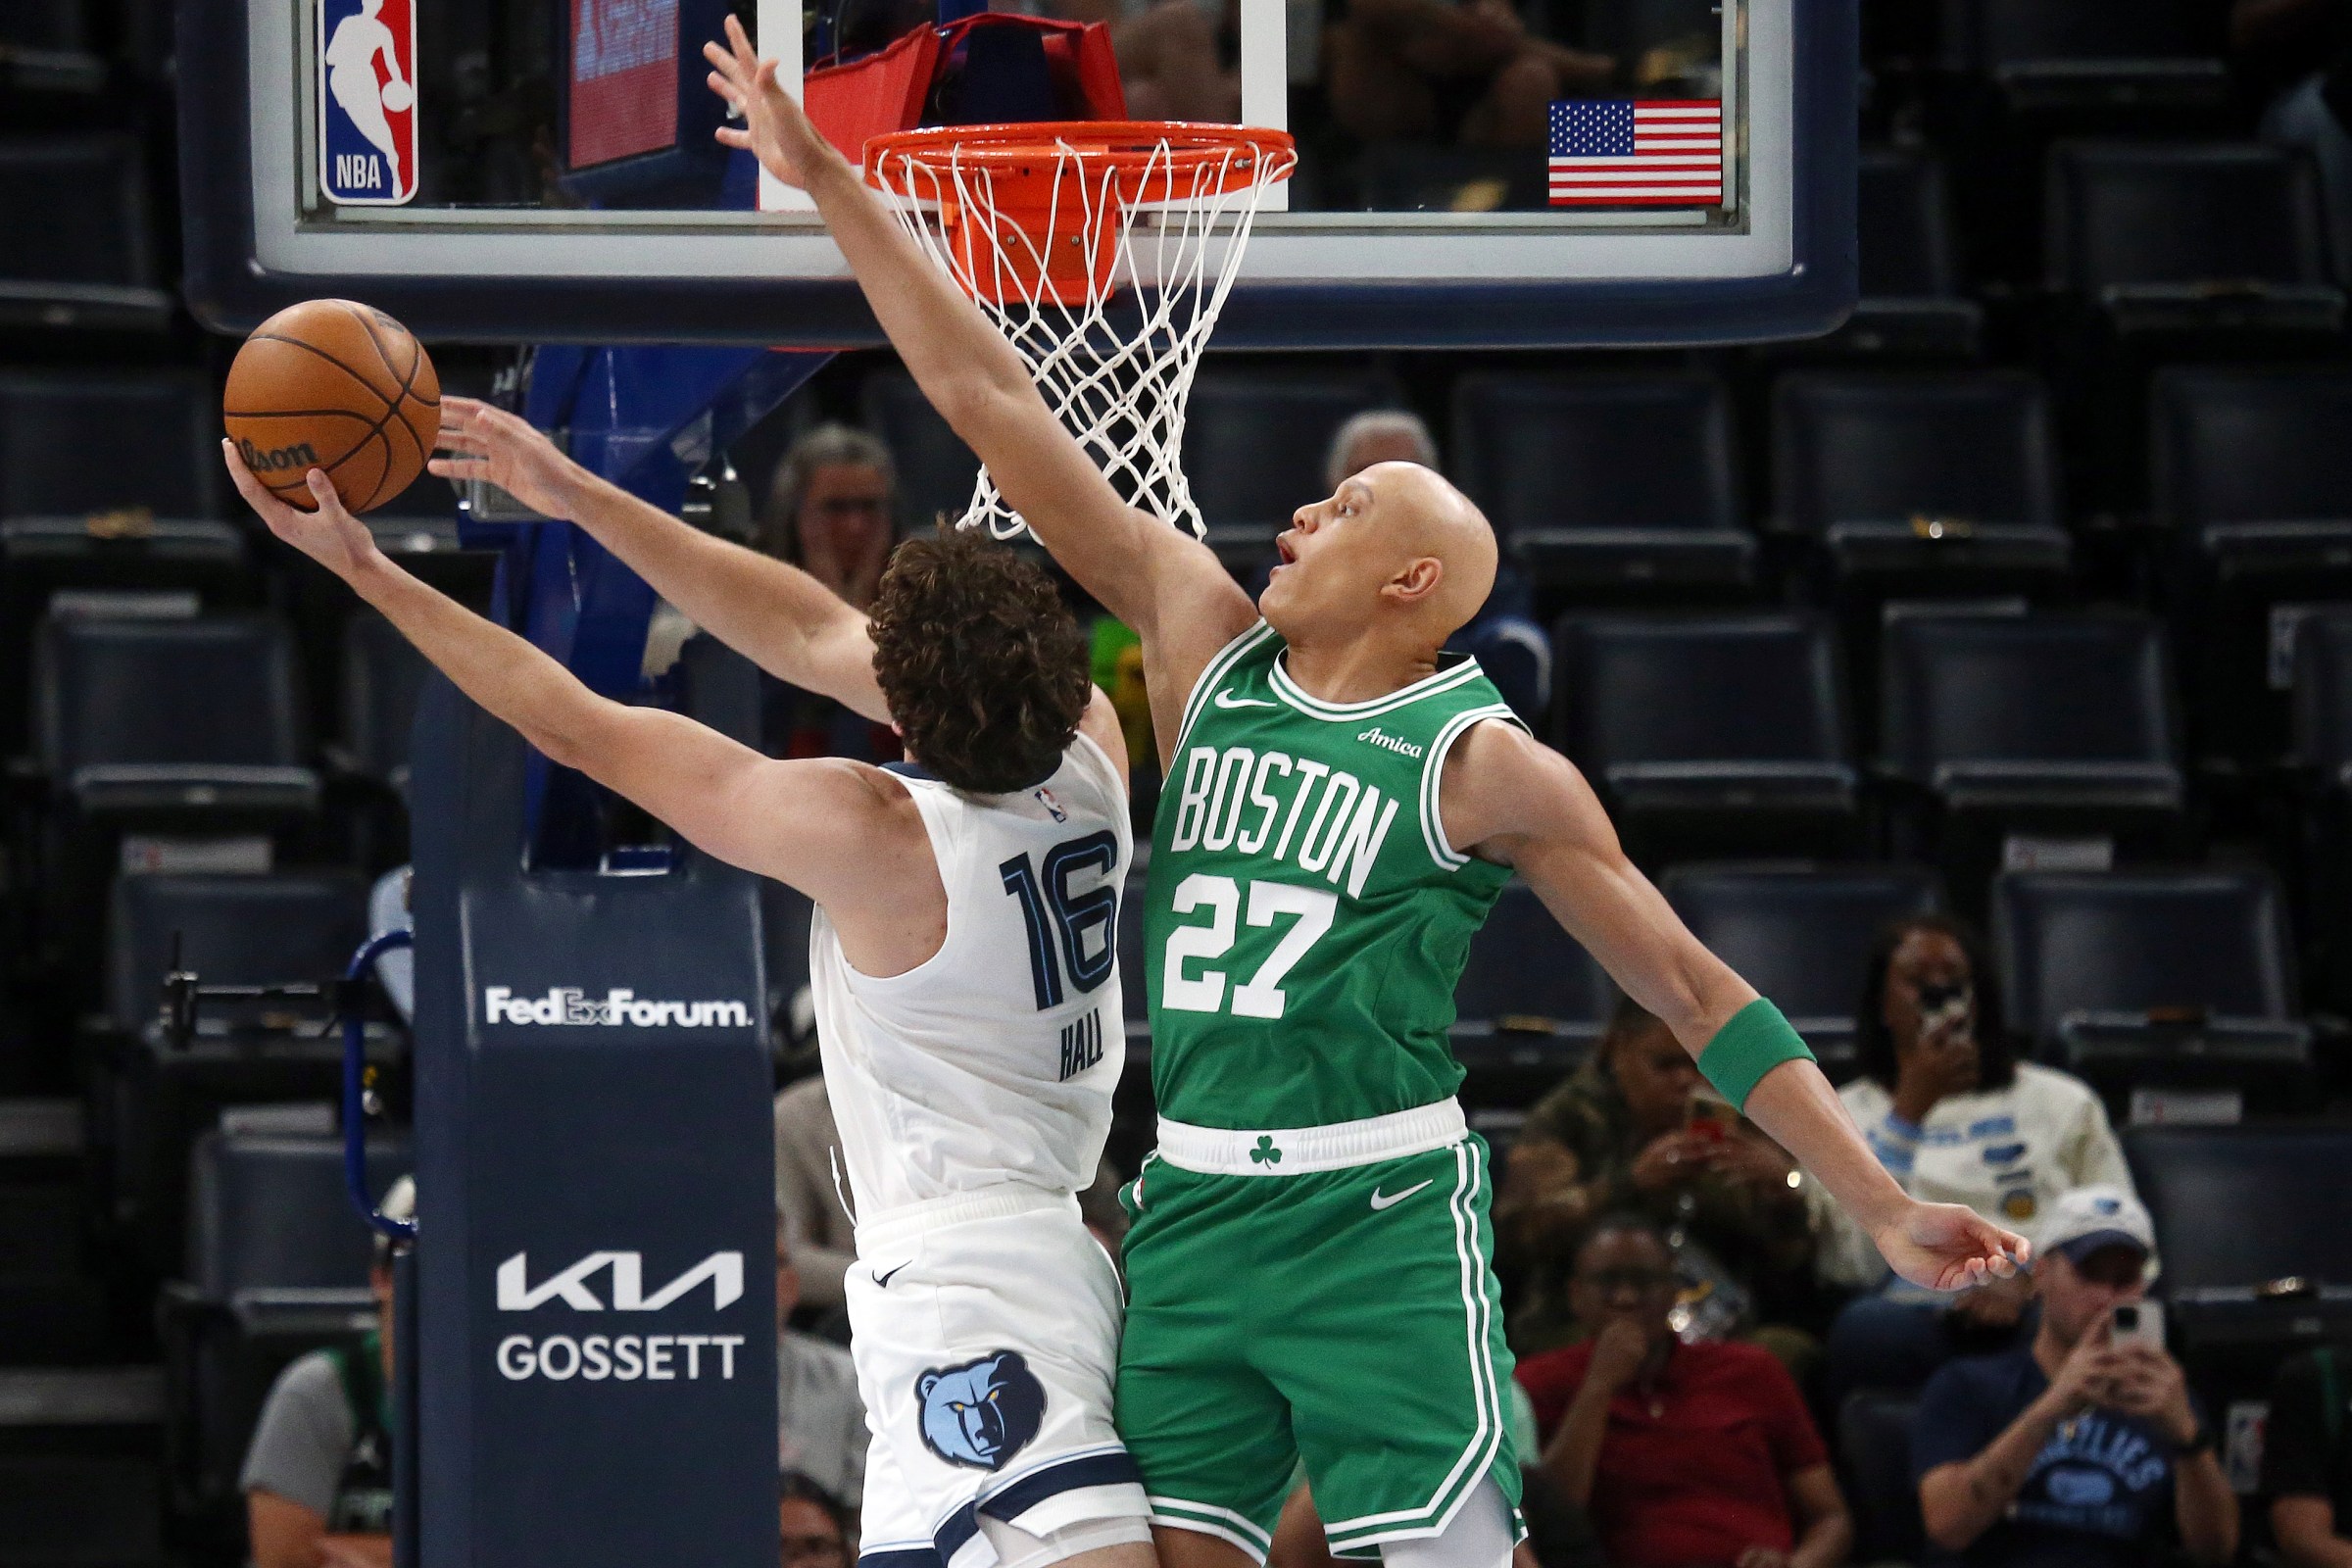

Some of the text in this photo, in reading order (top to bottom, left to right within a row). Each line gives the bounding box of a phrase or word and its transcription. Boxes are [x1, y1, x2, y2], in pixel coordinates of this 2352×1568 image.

[336, 154, 381, 189] NBA
[1357, 727, 1422, 759] Amica
[1171, 747, 1399, 900] BOSTON
[999, 830, 1117, 1010] 16
[1162, 873, 1339, 1019] 27
[1059, 1008, 1103, 1082] HALL
[497, 1250, 744, 1311] KIA
[497, 1335, 745, 1381] GOSSETT
